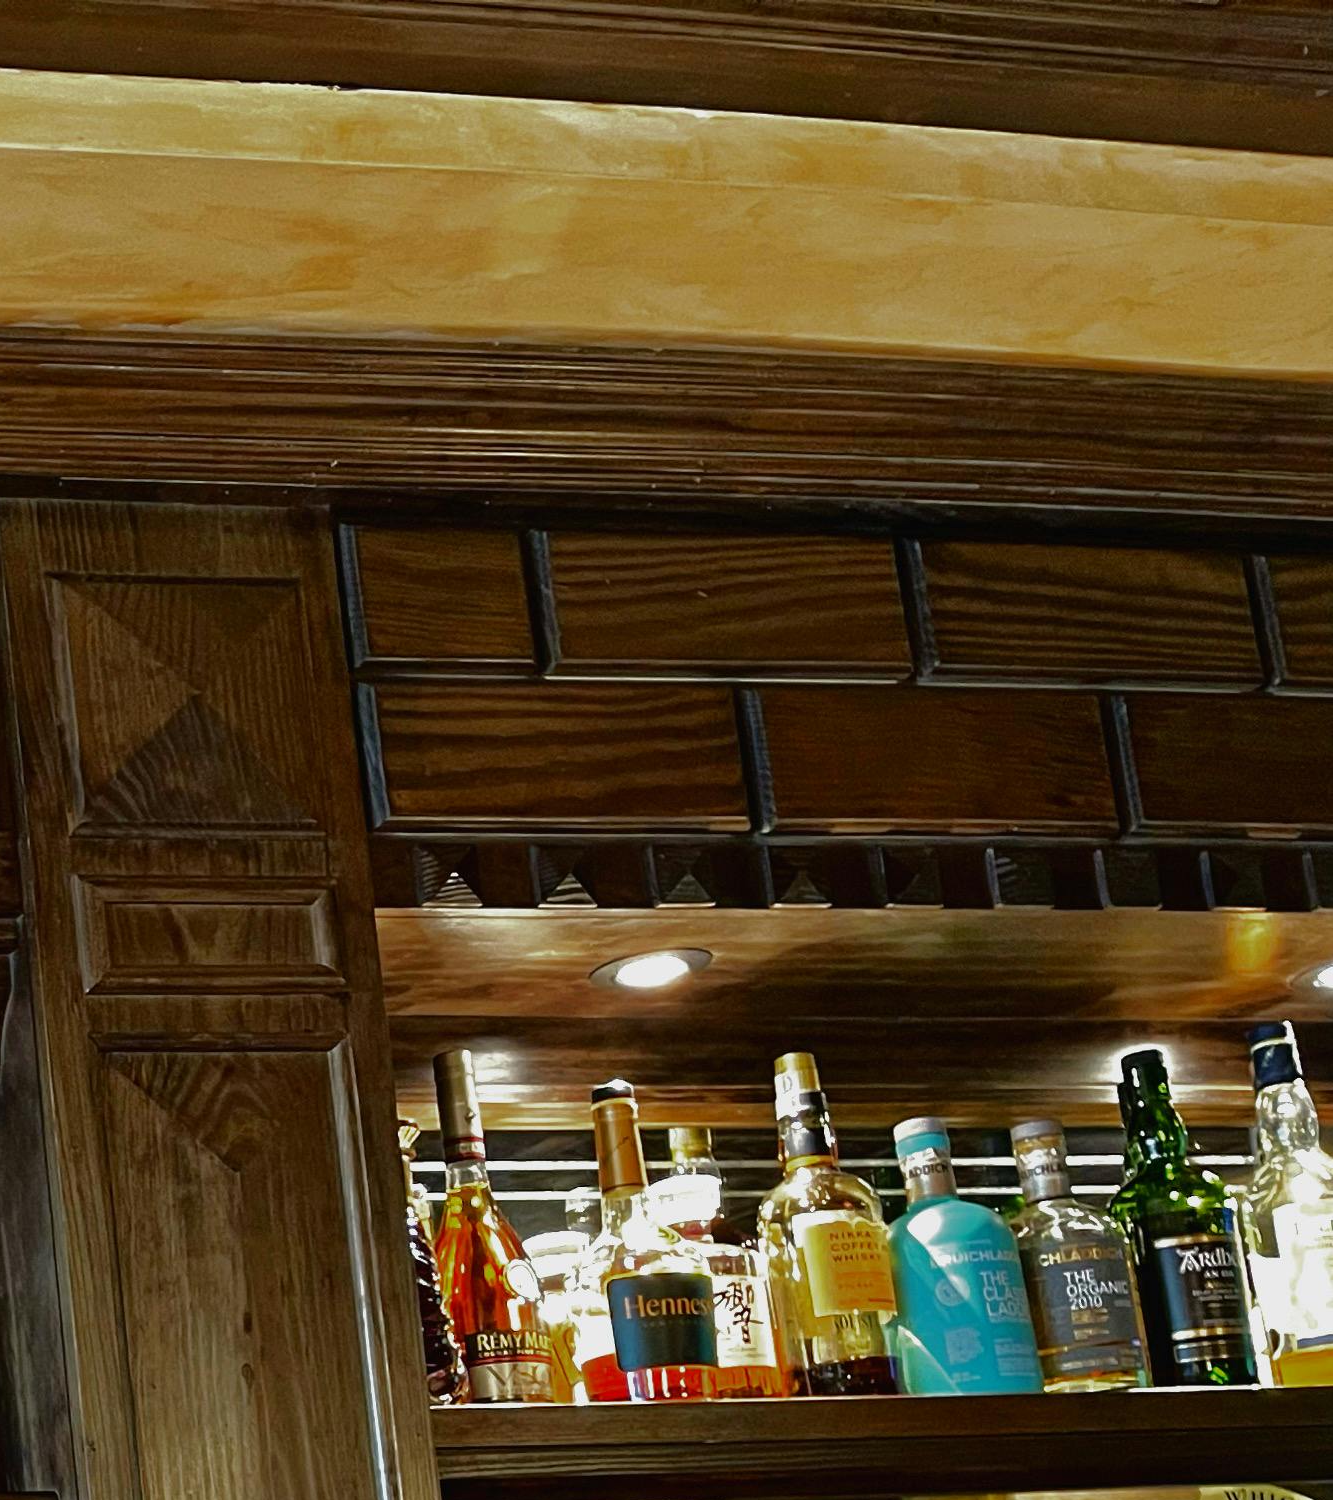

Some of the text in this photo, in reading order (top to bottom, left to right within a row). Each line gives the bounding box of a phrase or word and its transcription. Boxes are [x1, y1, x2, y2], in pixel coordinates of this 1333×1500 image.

[830, 1231, 872, 1240] NIKKA
[981, 1270, 1009, 1284] THE
[1063, 1269, 1095, 1284] THE
[1066, 1280, 1129, 1296] ORGANIC
[1070, 1296, 1103, 1310] 2010
